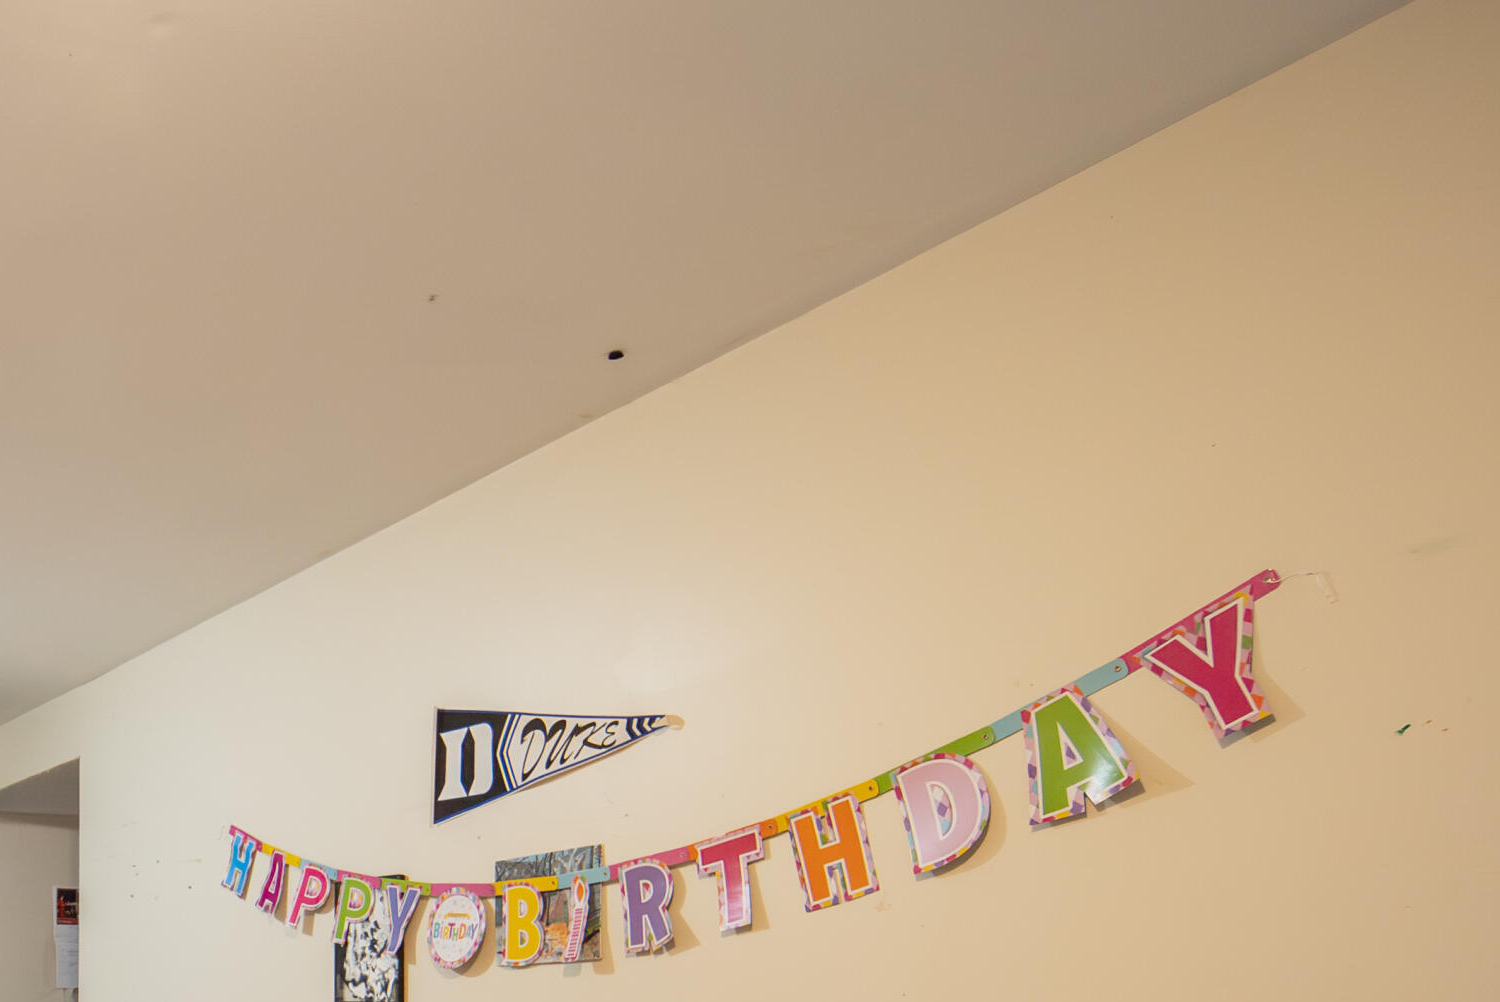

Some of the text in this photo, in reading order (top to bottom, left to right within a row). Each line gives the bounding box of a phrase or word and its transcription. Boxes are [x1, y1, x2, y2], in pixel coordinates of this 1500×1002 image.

[223, 598, 1260, 964] HAPPY BIRTHDAY
[437, 721, 494, 802] D
[519, 717, 620, 783] DUKE
[433, 921, 478, 942] BIRTHDAY
